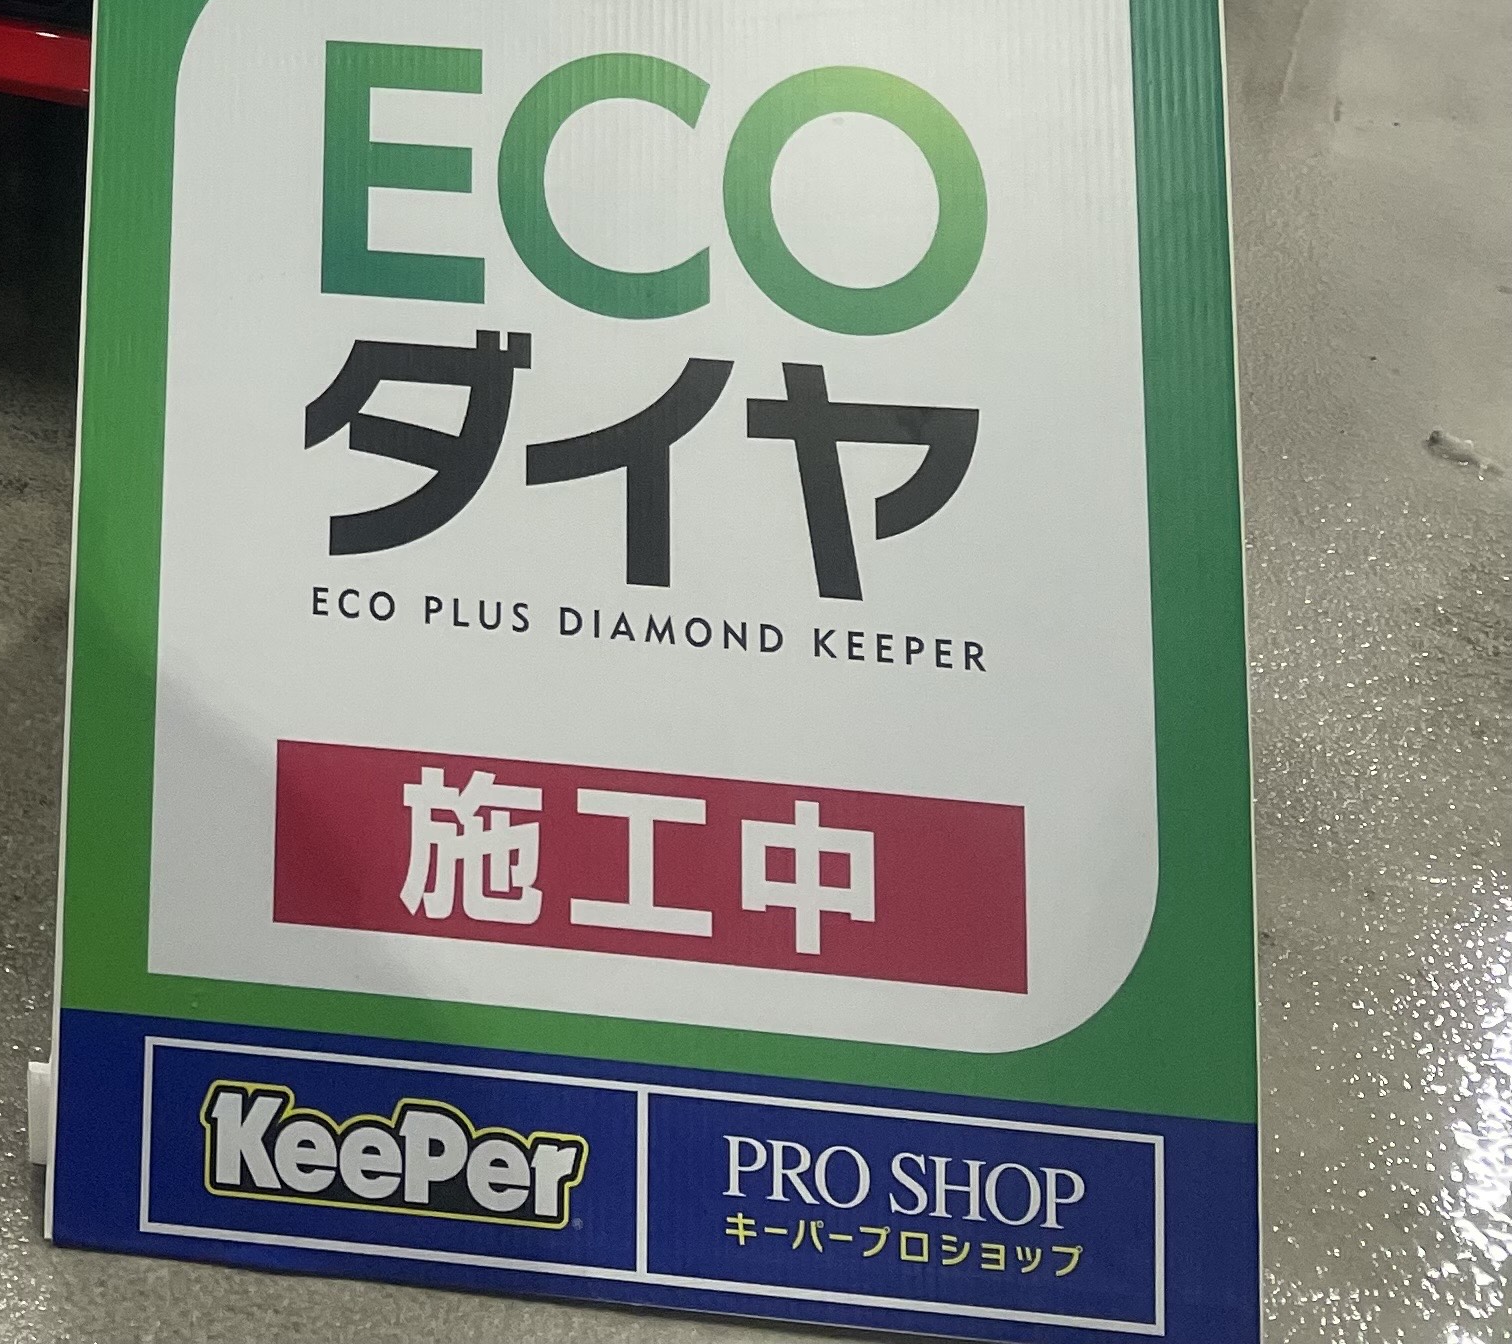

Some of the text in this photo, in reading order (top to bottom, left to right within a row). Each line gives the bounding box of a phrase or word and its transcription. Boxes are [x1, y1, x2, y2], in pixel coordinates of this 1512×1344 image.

[320, 40, 988, 336] ECO
[305, 329, 981, 601] ダイヤ
[311, 586, 988, 672] ECO PLUS DIAMOND KEEPER
[399, 767, 877, 955] 施工中
[205, 1084, 585, 1225] KeePer
[722, 1135, 1086, 1230] PRO SHOP
[725, 1212, 1084, 1277] キーパープロショップ
